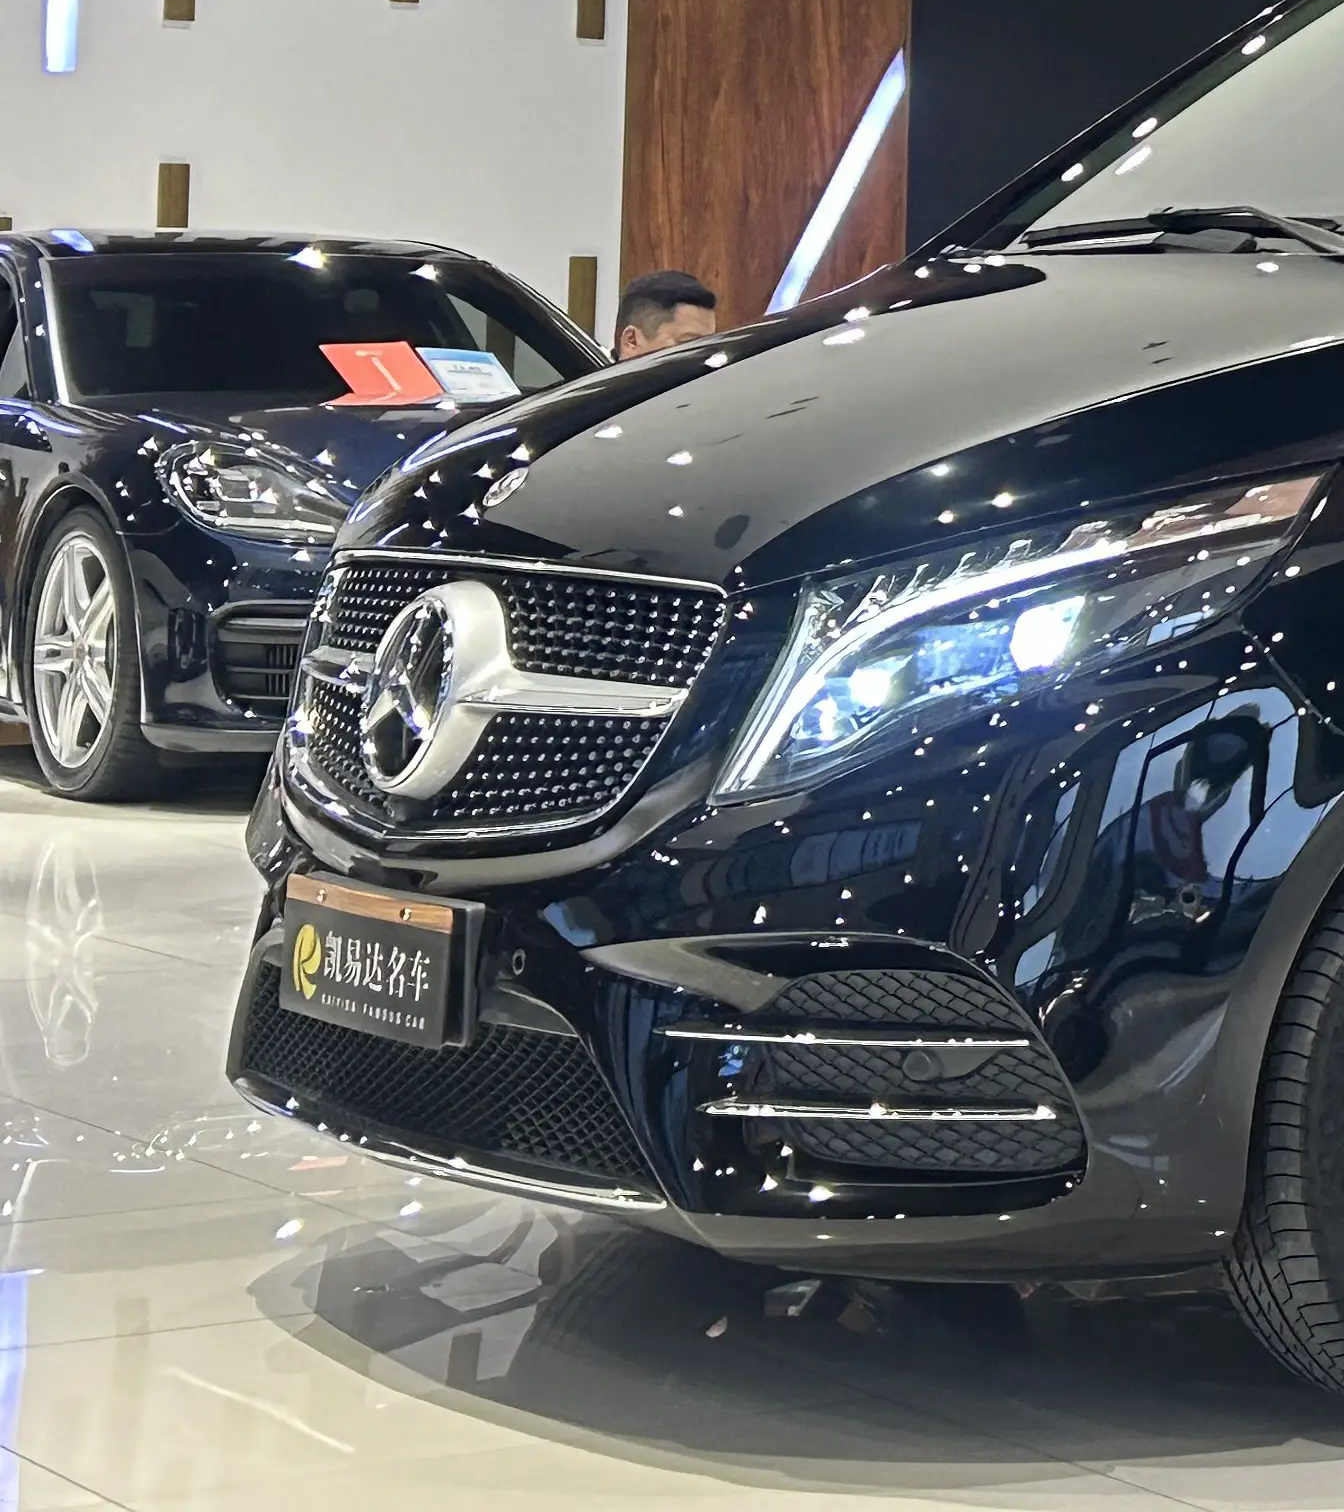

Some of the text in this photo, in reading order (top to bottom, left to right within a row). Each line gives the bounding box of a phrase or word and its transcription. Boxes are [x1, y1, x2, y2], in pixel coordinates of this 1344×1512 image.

[323, 930, 430, 1002] 凯易达名车
